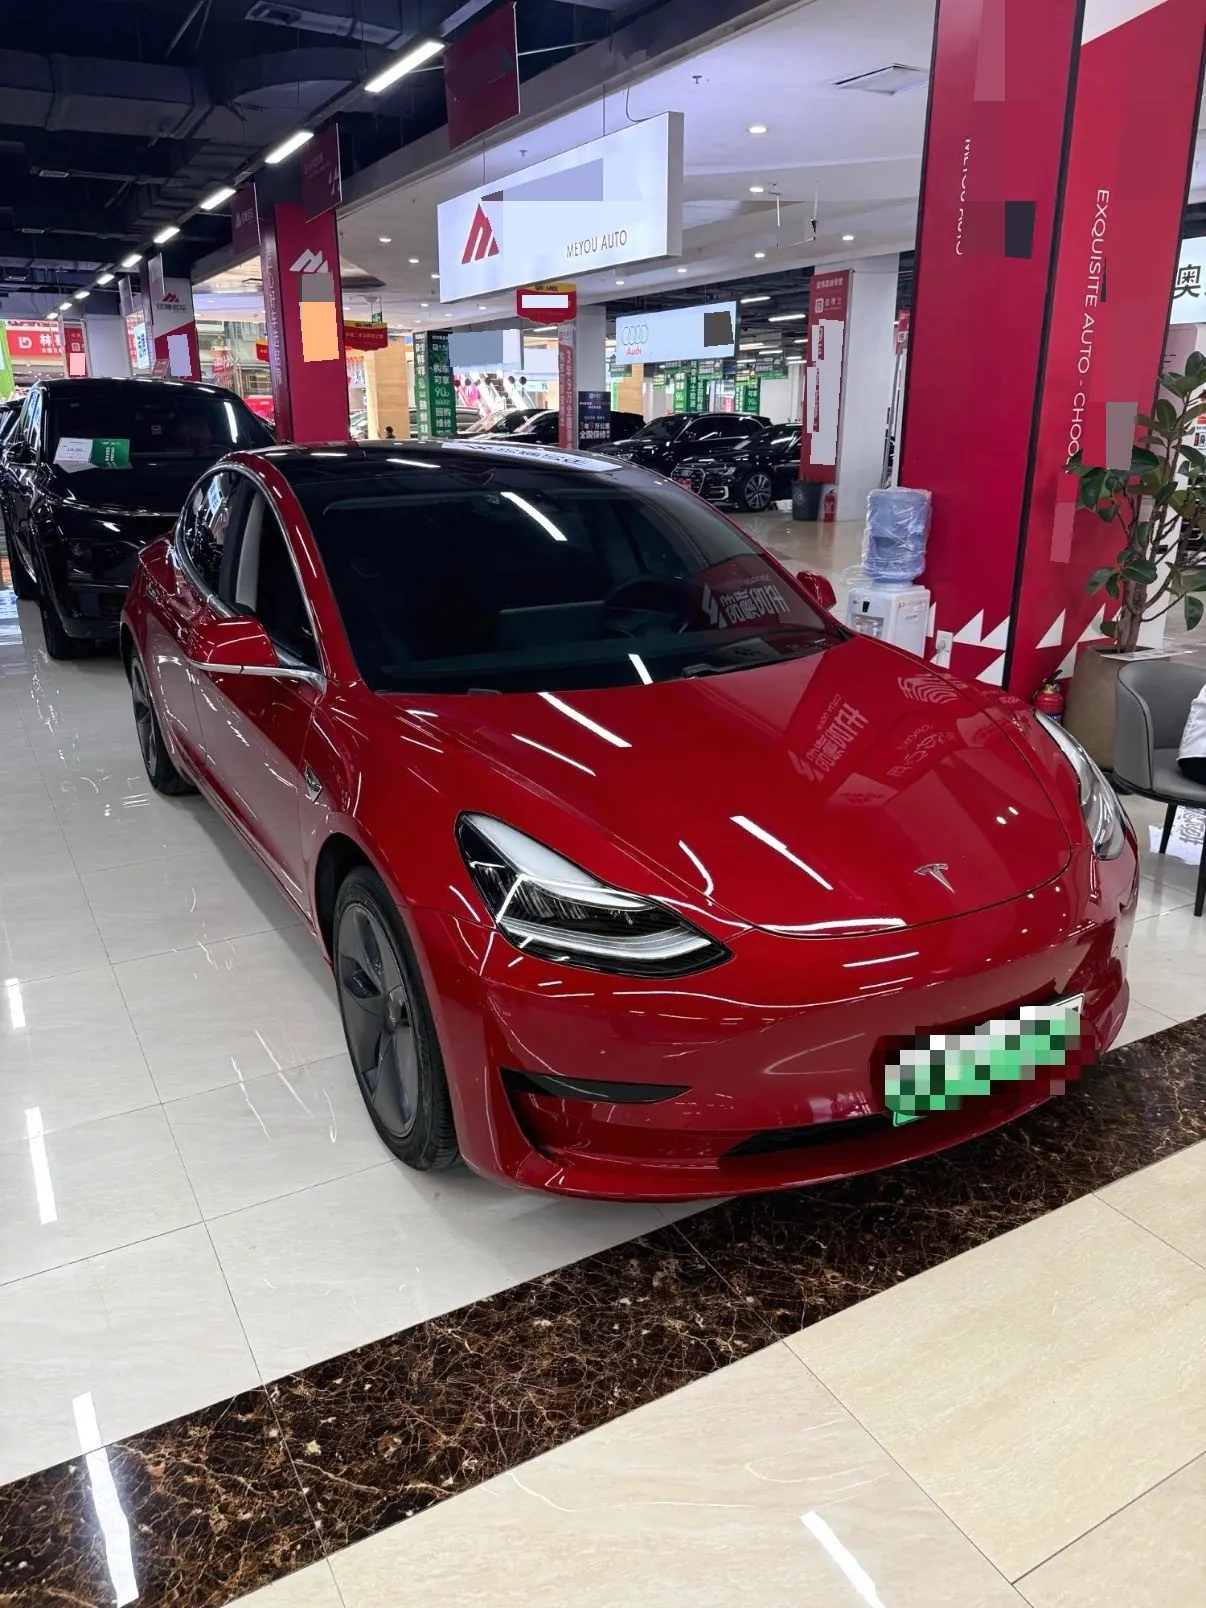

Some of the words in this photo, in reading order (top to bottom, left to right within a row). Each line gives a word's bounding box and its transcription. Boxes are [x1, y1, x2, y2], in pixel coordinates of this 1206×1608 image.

[566, 236, 598, 258] MEYOU
[600, 229, 628, 251] AUTO
[1084, 189, 1110, 308] EXQUISITE
[1173, 263, 1206, 299] 奥
[626, 347, 642, 356] Audi
[1077, 312, 1095, 375] AUTO
[433, 364, 450, 374] 购车
[434, 375, 450, 385] 可享
